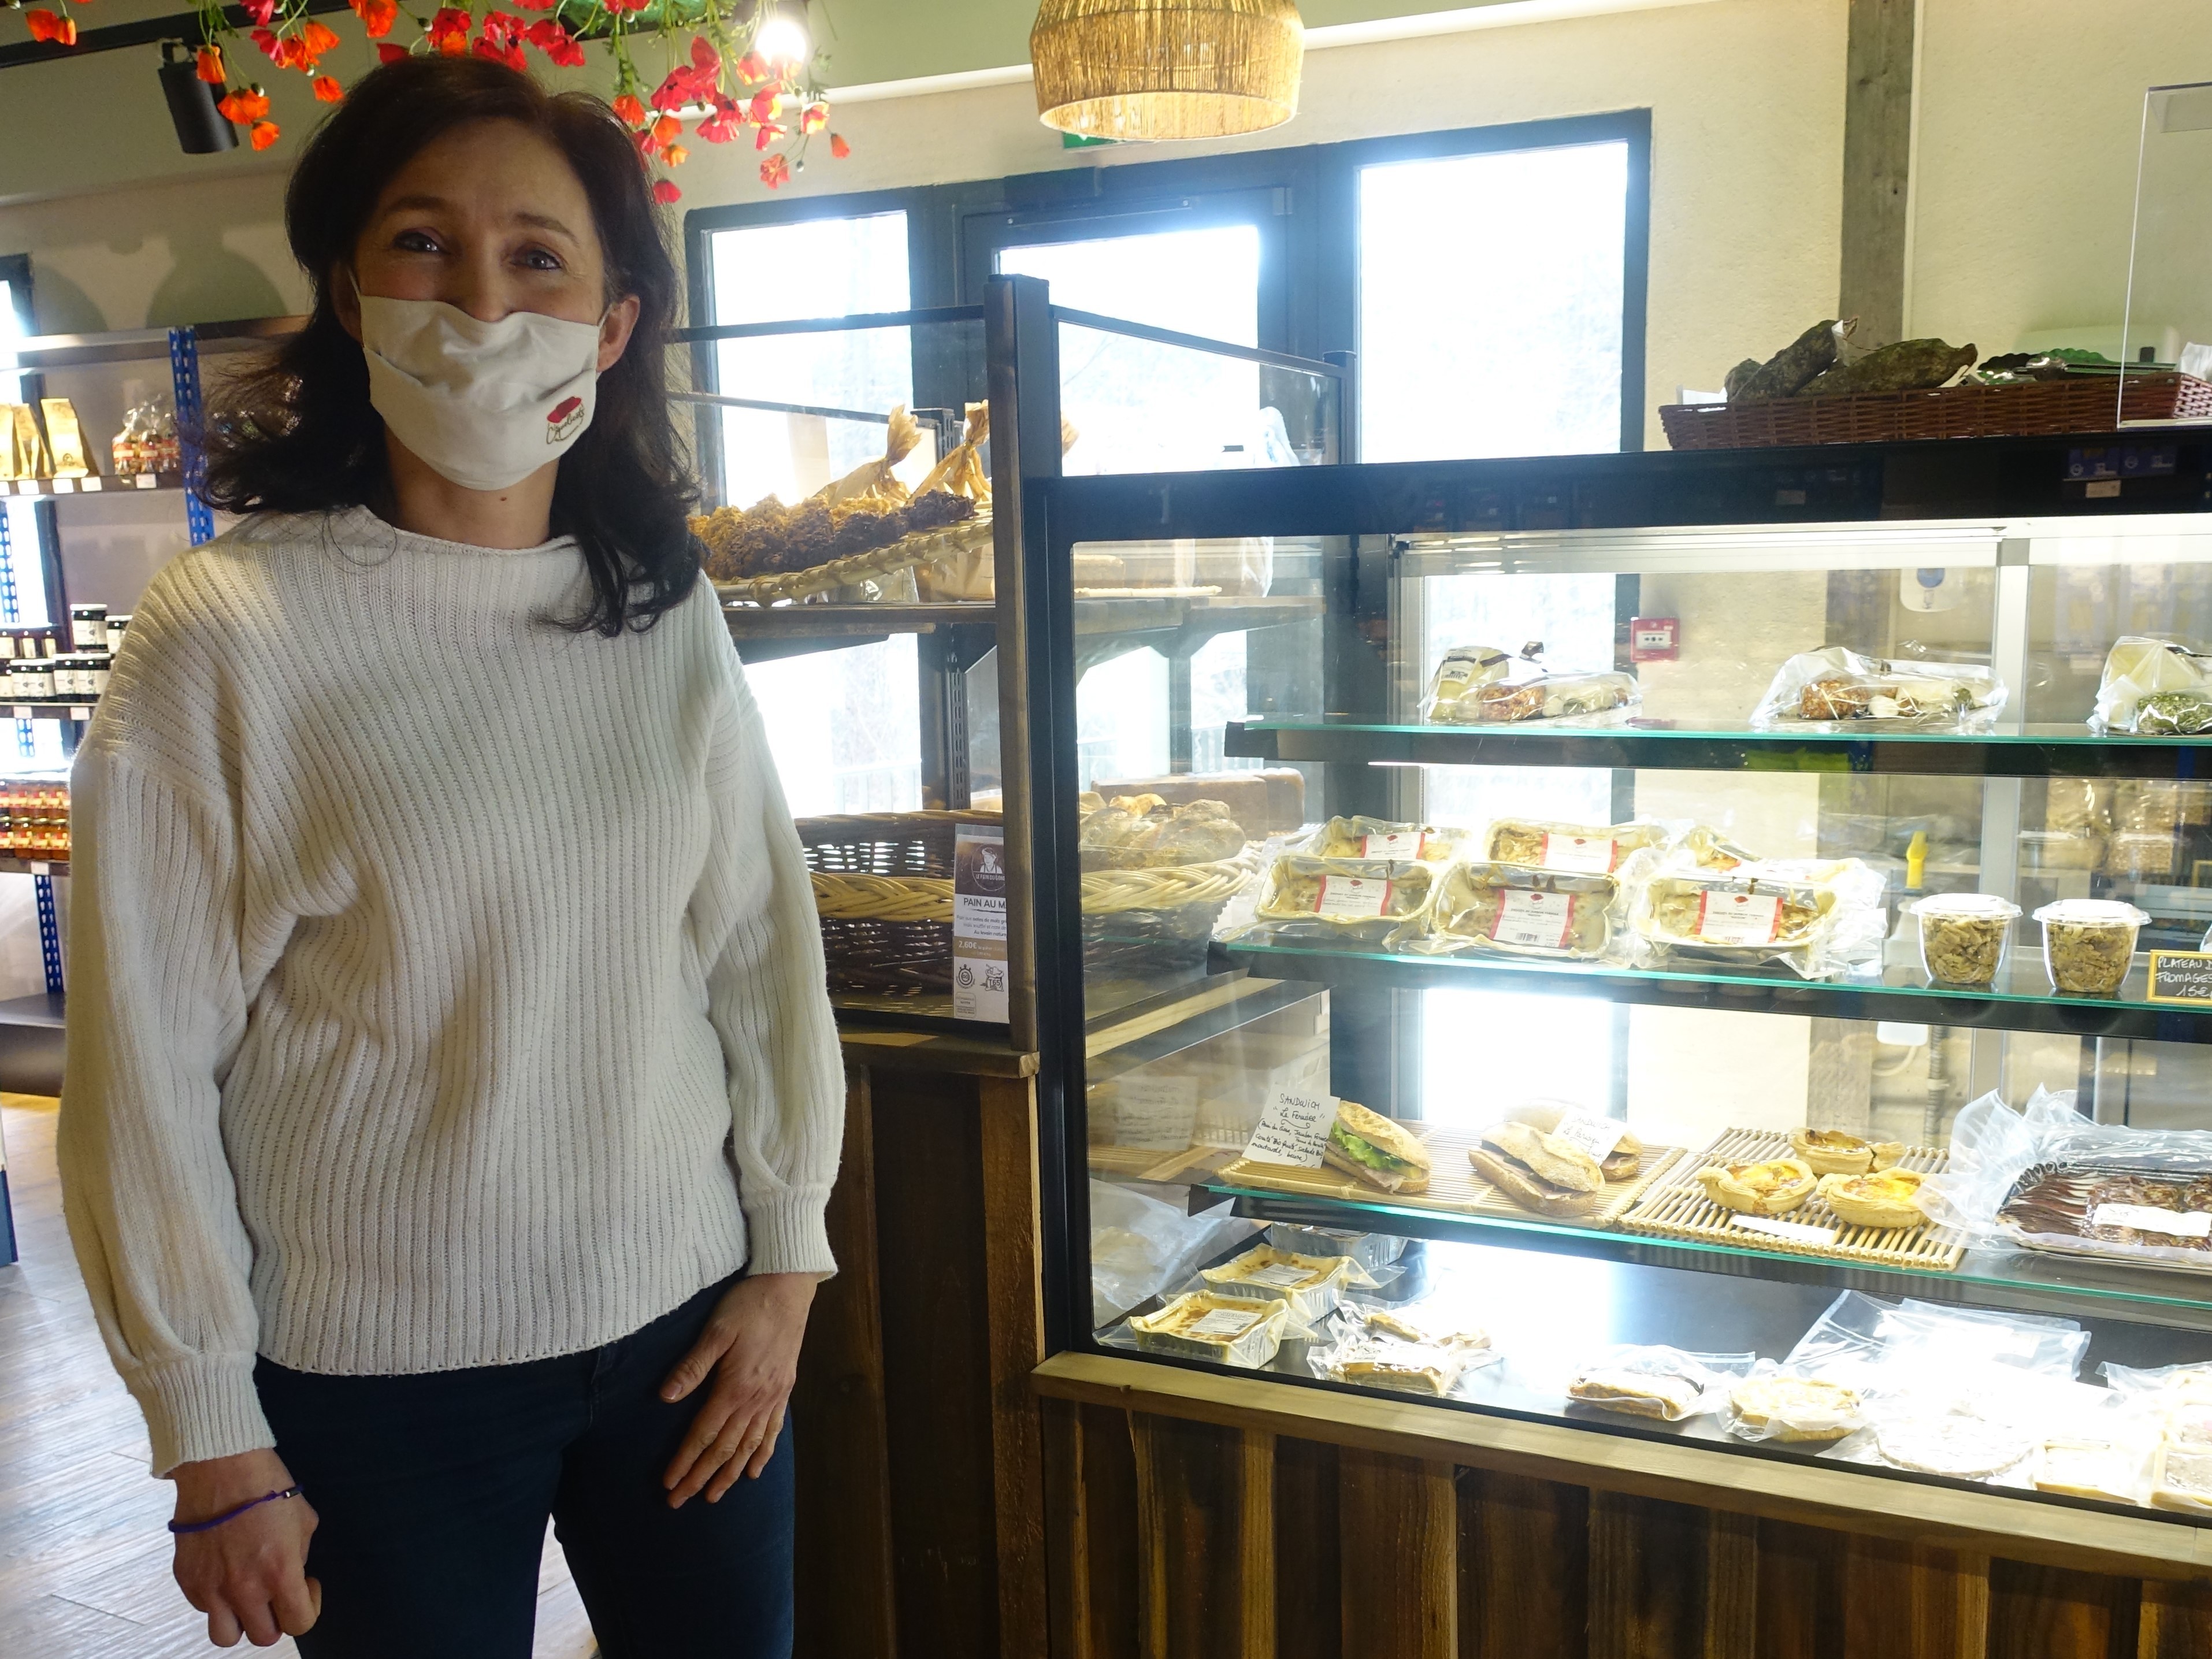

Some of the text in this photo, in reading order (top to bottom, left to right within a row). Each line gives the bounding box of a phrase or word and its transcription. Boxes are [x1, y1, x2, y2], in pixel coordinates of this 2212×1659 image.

[963, 897, 1006, 909] PAIN AU M
[959, 940, 977, 949] 2,60€
[2158, 956, 2203, 968] PLATEAU
